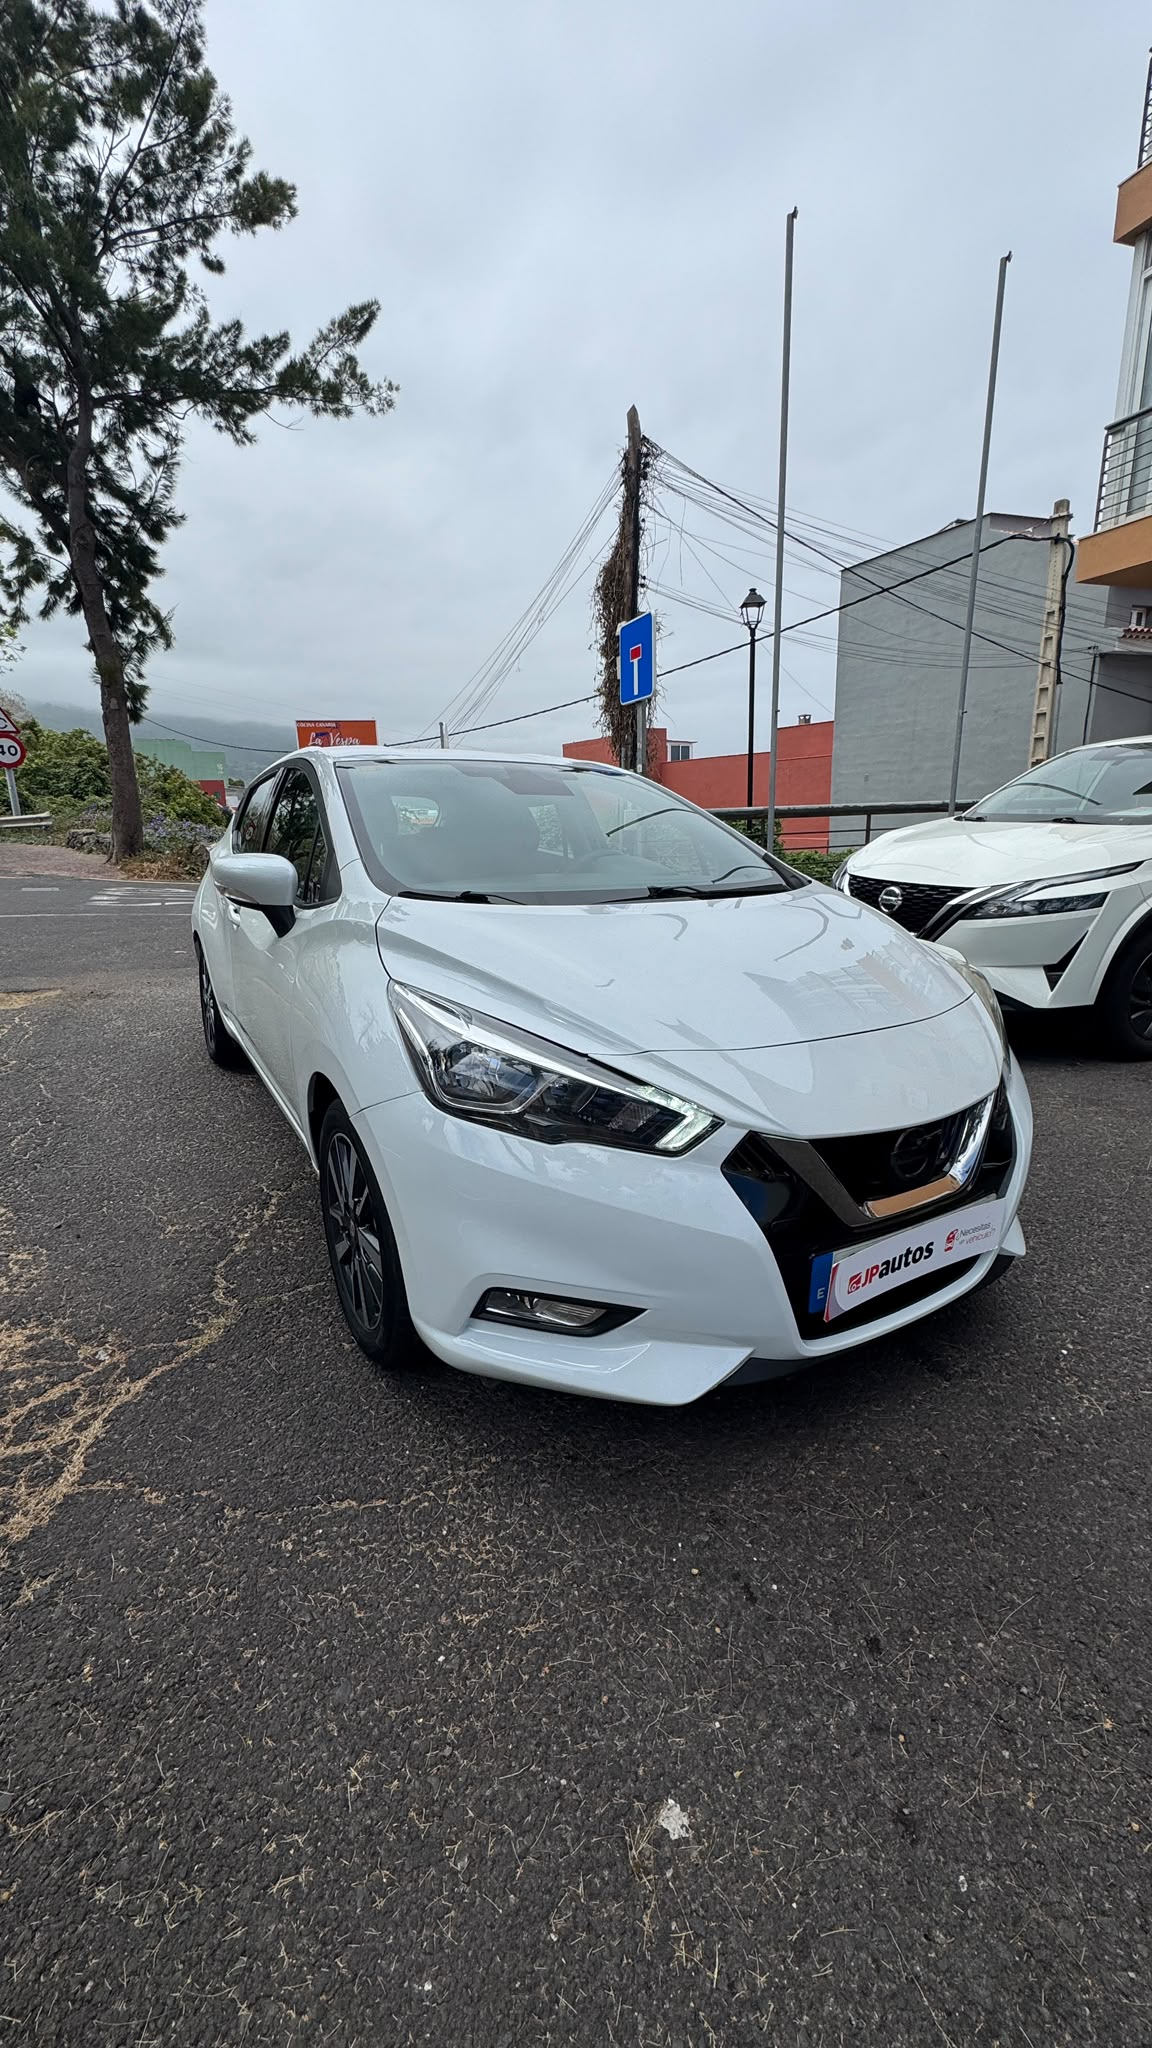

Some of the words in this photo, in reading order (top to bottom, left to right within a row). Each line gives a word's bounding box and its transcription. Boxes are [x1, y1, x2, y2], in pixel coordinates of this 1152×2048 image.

[308, 732, 323, 746] La
[329, 732, 360, 746] Vespa
[816, 1288, 825, 1300] E
